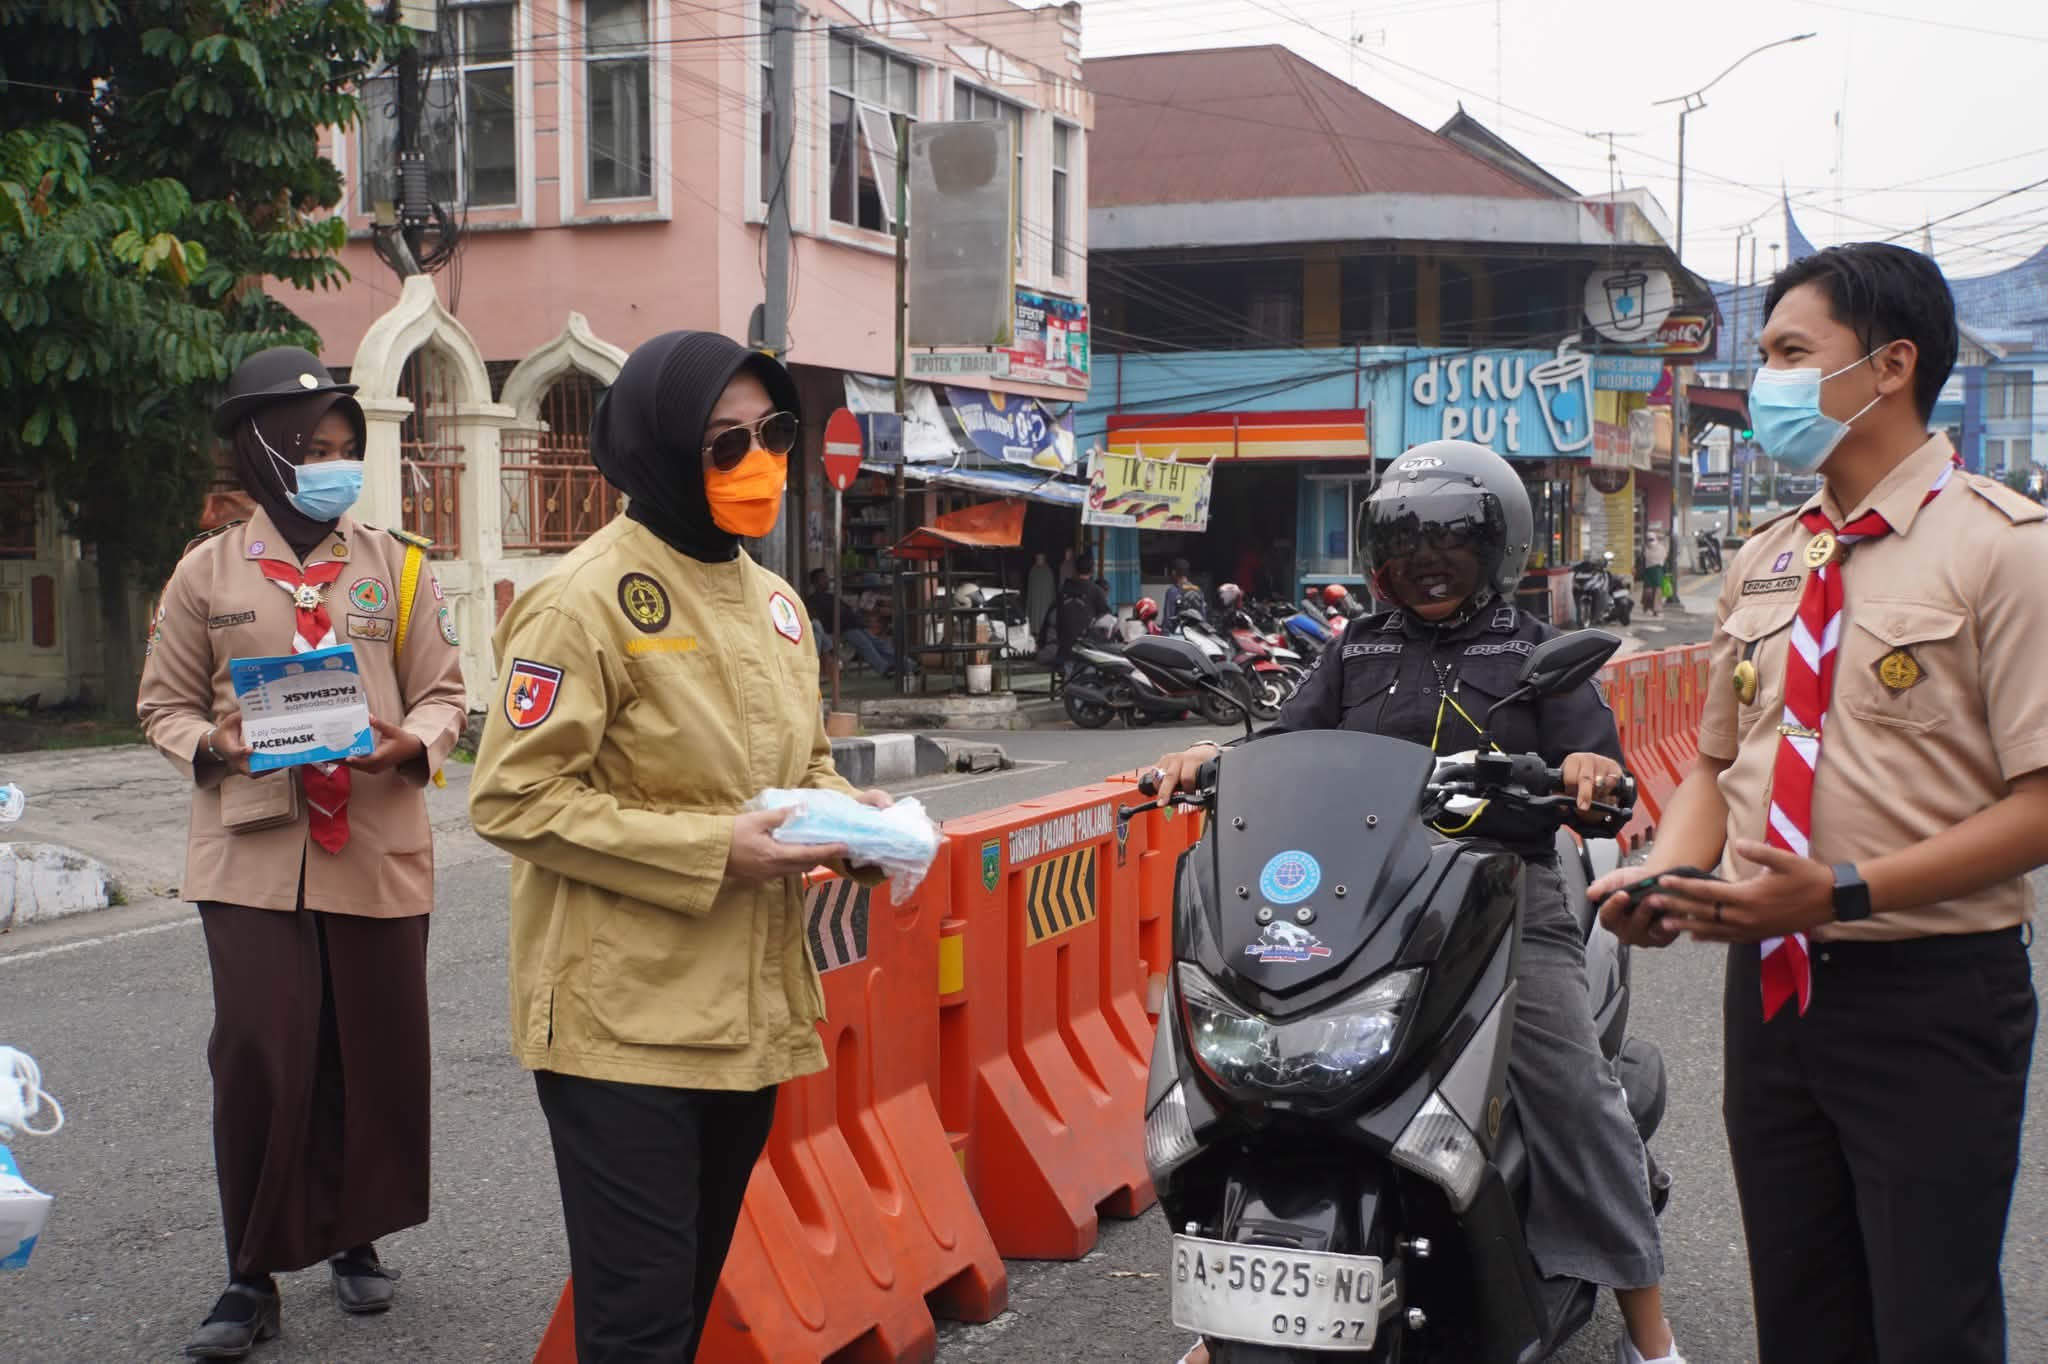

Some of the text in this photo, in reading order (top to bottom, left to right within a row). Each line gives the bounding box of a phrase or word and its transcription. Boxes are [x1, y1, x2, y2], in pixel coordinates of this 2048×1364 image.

[283, 685, 357, 704] FACEMASK
[252, 733, 315, 750] FACEMASK
[1009, 802, 1112, 864] DISHUB PADANG PANJANG
[1228, 1255, 1311, 1297] 5625
